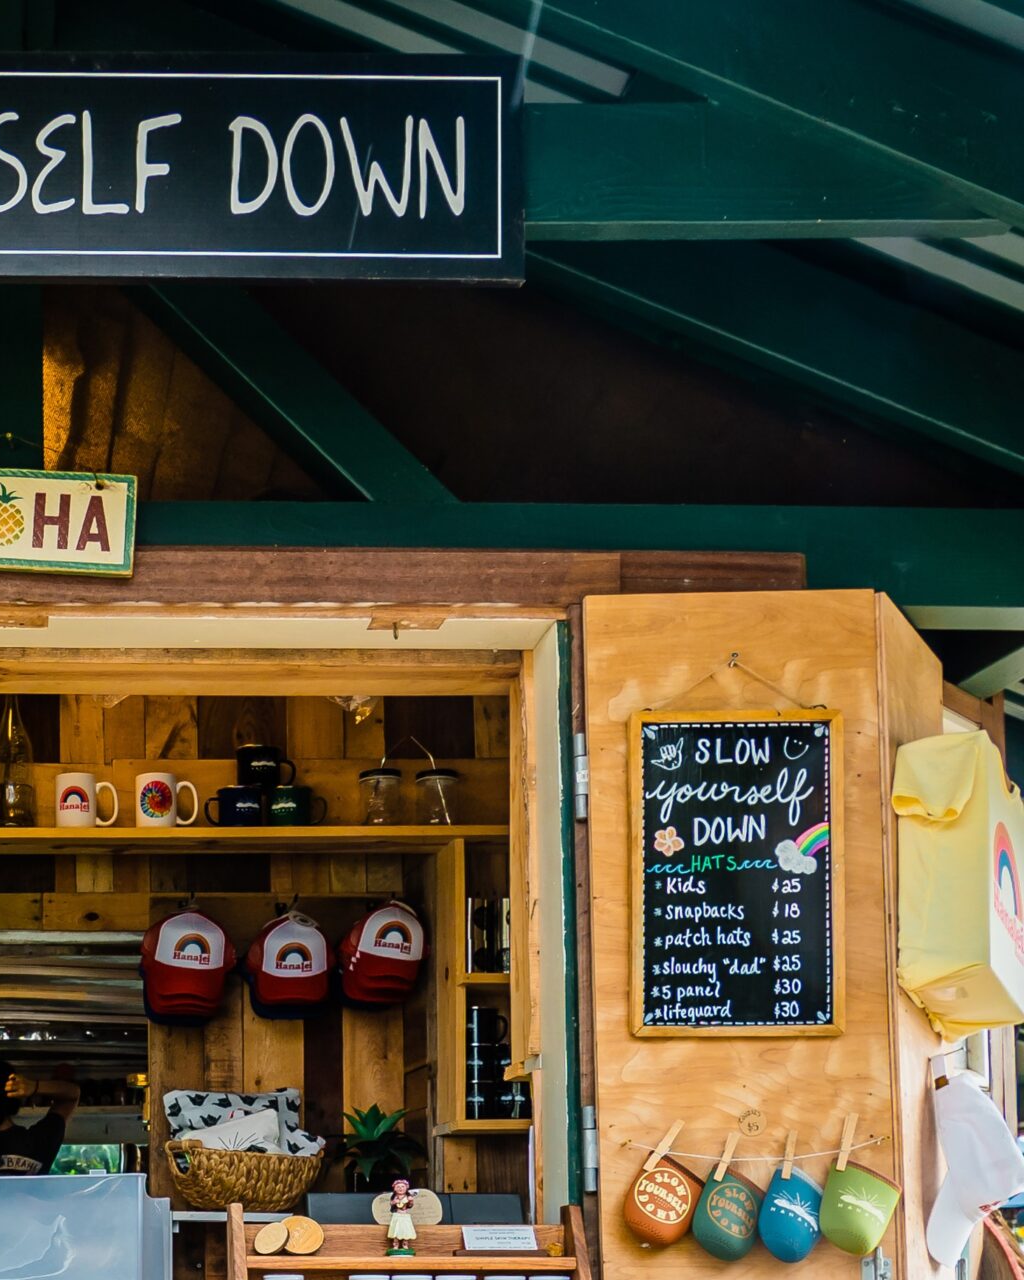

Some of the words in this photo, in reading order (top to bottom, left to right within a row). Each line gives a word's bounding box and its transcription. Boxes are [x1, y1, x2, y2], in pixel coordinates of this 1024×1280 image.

[230, 113, 468, 220] DOWN
[694, 736, 770, 766] SLOW
[646, 767, 814, 827] yourself
[692, 814, 766, 847] DOWN
[691, 854, 737, 873] HATS
[666, 878, 706, 894] Kids
[665, 903, 745, 924] snapbacks
[374, 937, 412, 955] Hanalei
[665, 927, 712, 950] patch
[717, 927, 751, 946] hats
[771, 928, 801, 945] $25
[172, 950, 212, 966] Hanalei
[275, 960, 313, 973] Hanalei
[663, 956, 717, 984] slouchy
[773, 954, 802, 972] $25
[661, 984, 672, 1000] 5
[676, 980, 721, 1002] panel
[774, 978, 802, 996] $30
[663, 999, 731, 1024] lifeguard
[774, 1001, 799, 1019] $30
[638, 1179, 688, 1215] YOURSELF
[653, 1171, 688, 1198] SLOW
[638, 1193, 677, 1221] DOWN
[711, 1194, 756, 1231] YOURSELF
